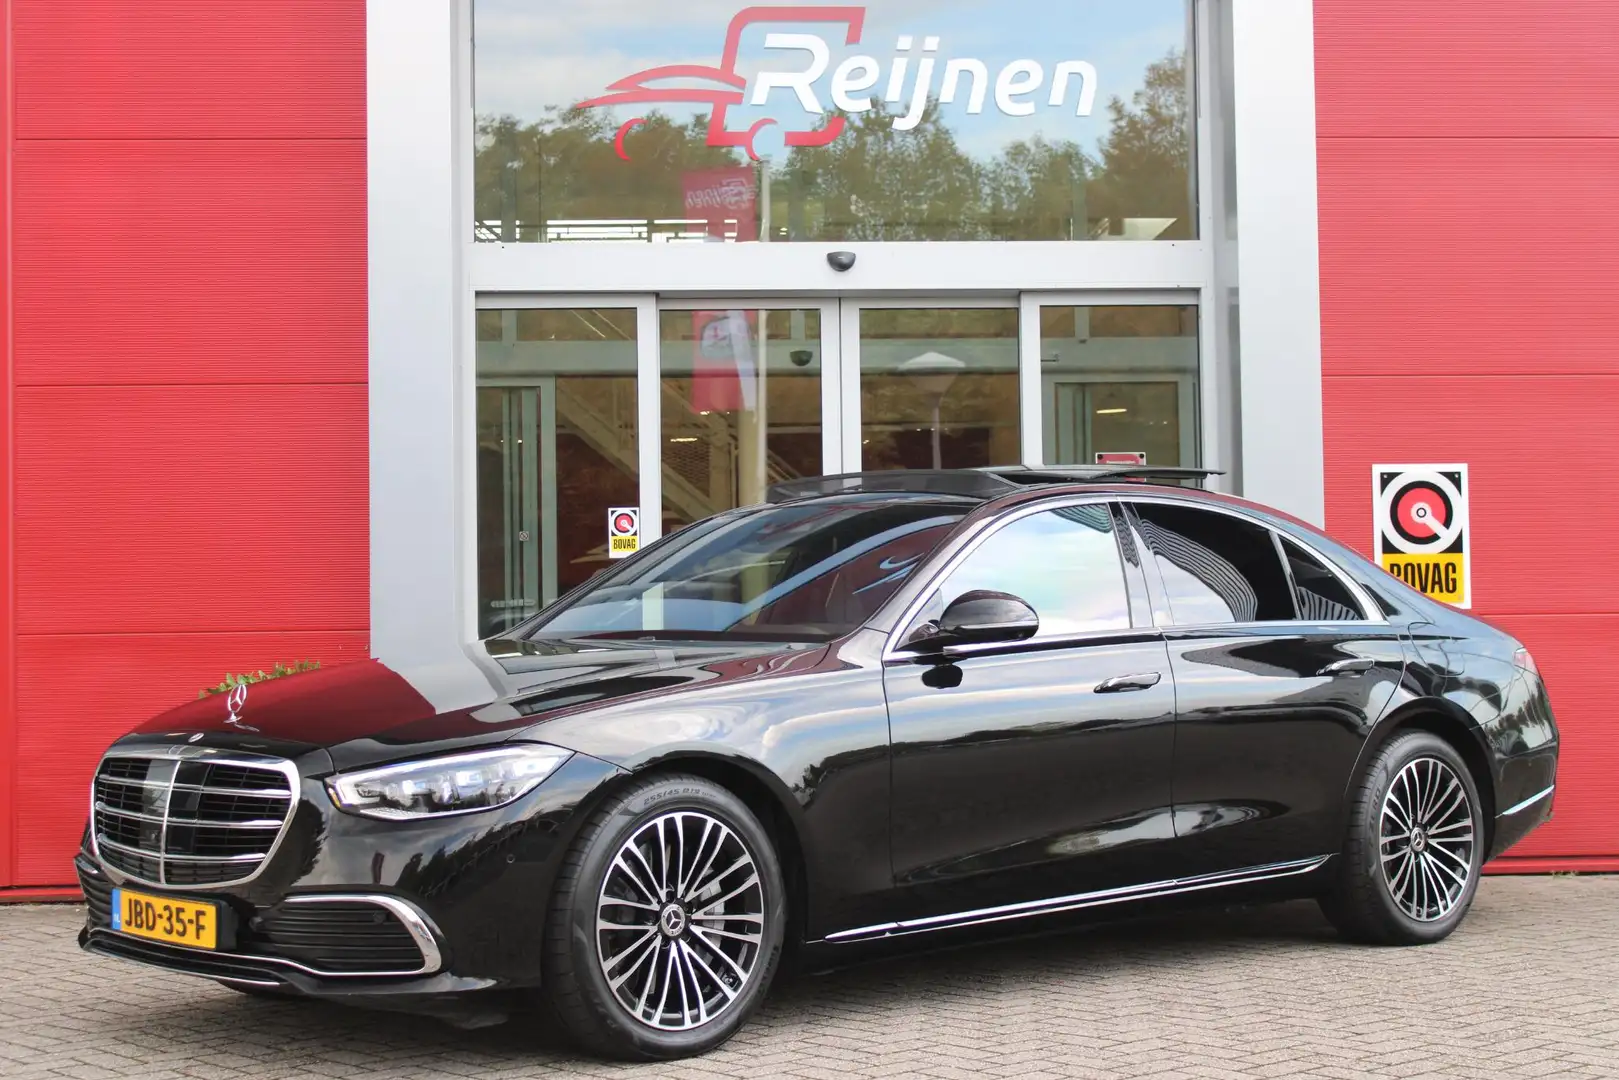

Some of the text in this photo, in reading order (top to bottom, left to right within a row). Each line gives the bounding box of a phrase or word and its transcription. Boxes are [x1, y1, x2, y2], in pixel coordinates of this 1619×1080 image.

[750, 33, 1097, 130] Reijnen
[613, 538, 636, 550] BOVAG
[644, 788, 681, 805] 255/45
[125, 898, 206, 940] JBD-35-F
